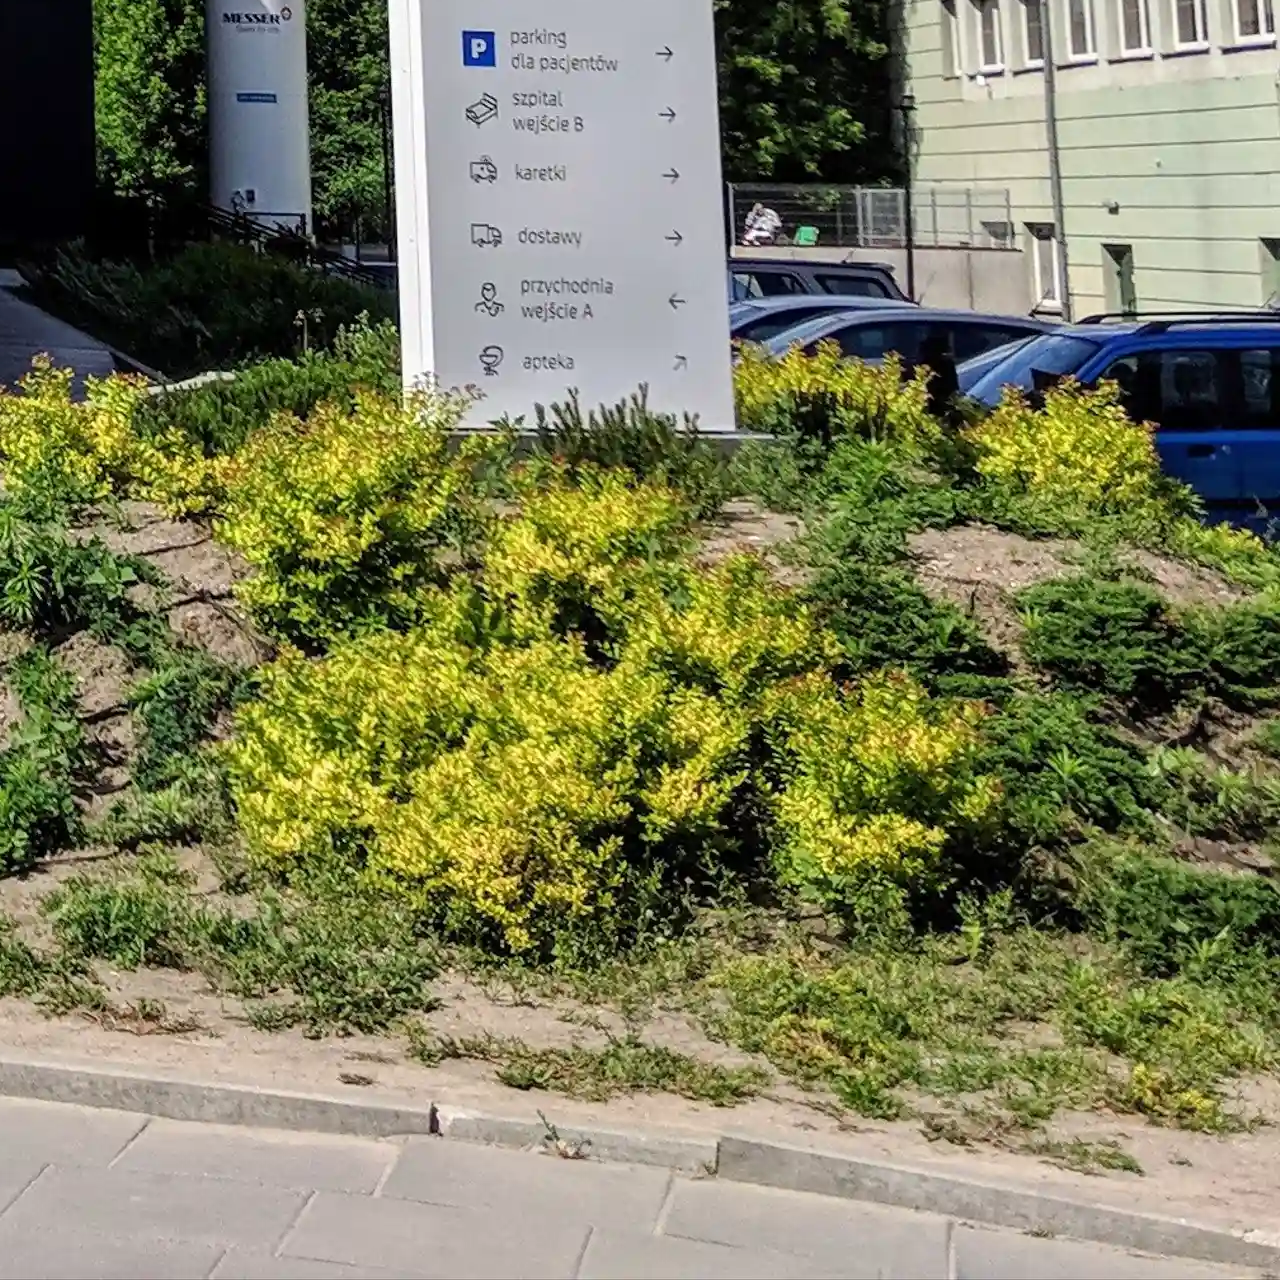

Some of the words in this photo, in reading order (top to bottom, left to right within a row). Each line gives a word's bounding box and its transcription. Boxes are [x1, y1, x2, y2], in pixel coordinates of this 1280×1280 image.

[223, 12, 280, 25] MESSER
[471, 38, 487, 58] P
[510, 29, 567, 48] parking
[511, 54, 536, 71] dla
[540, 55, 619, 74] pacjentów
[512, 90, 563, 108] szpital
[513, 114, 570, 133] wejście
[574, 117, 584, 132] B
[515, 163, 566, 181] karetki
[518, 227, 582, 248] dostawy
[521, 276, 614, 296] przychodnia
[521, 301, 578, 322] wejście
[583, 303, 593, 318] A
[522, 352, 574, 372] apteka
